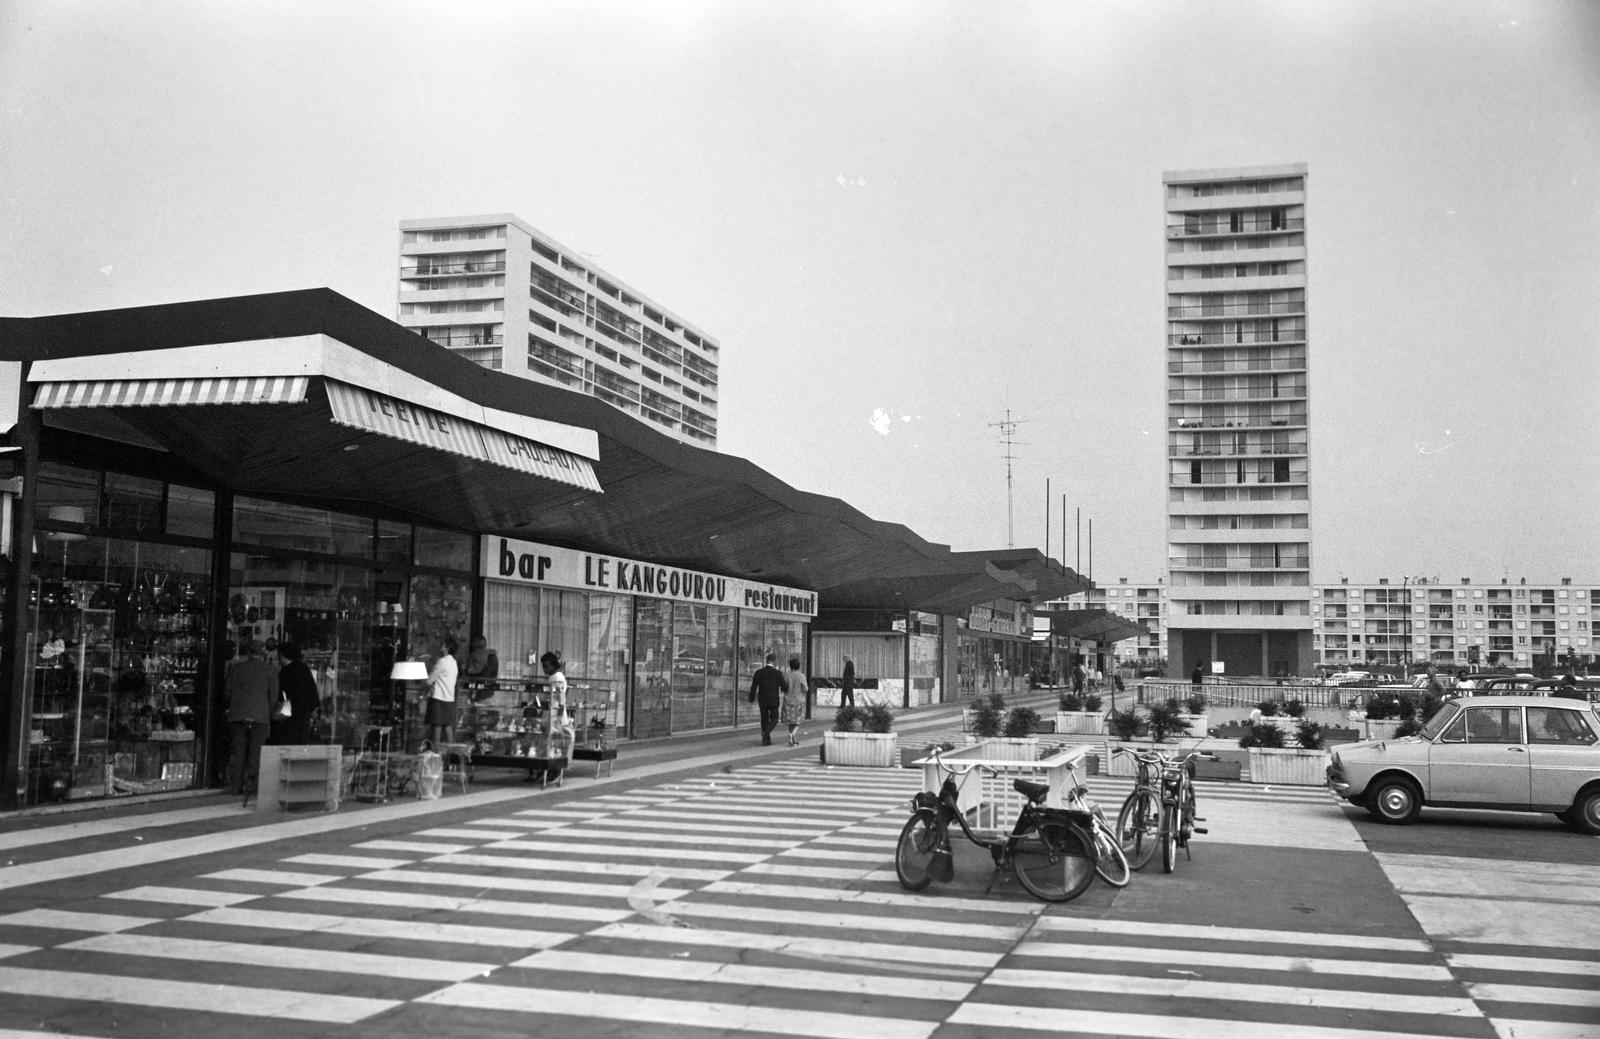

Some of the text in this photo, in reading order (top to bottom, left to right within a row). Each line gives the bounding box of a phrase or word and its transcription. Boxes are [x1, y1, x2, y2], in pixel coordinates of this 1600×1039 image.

[499, 539, 815, 614] bar LE KANGOUROU restaurant
